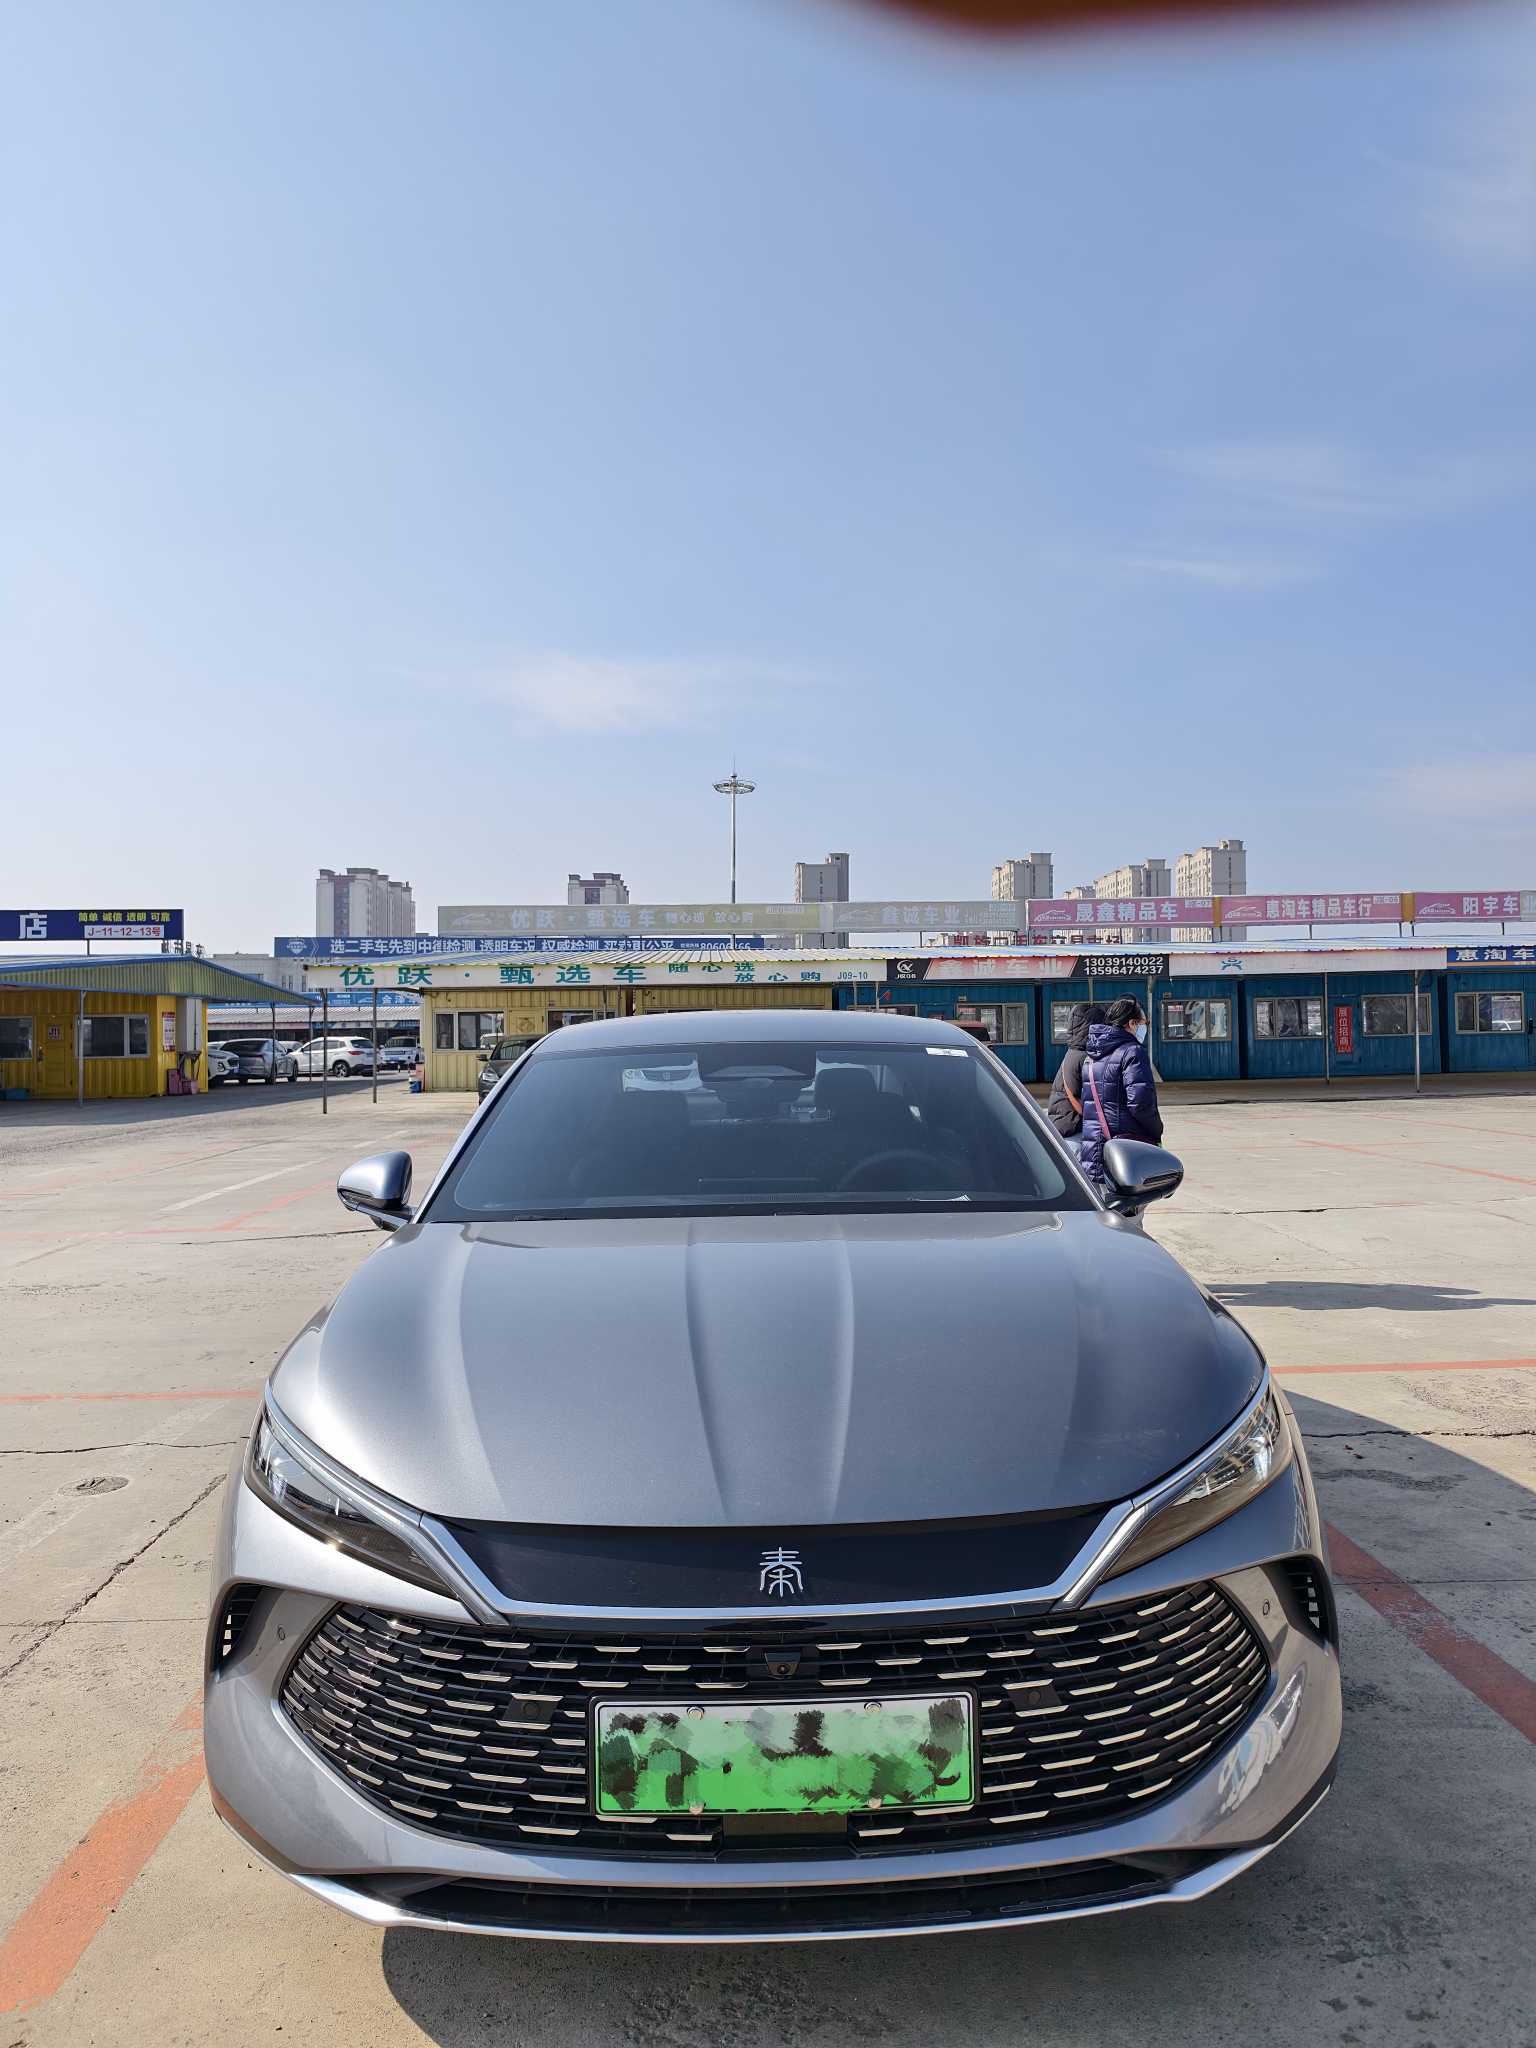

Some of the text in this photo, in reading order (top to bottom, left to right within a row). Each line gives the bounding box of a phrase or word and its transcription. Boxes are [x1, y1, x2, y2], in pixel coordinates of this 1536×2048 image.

[1075, 902, 1178, 923] 晟鑫精品车
[1266, 898, 1372, 918] 惠淘车精品车行
[18, 912, 48, 939] 店
[87, 927, 161, 937] J-11-12-13号
[700, 942, 750, 950] 8060666
[1455, 948, 1535, 961] 惠淘车
[1084, 957, 1164, 967] 13039140022
[735, 971, 821, 982] 放心购
[837, 971, 868, 980] J09-10
[1084, 966, 1164, 976] 13596474237
[760, 1546, 804, 1598] 秦
